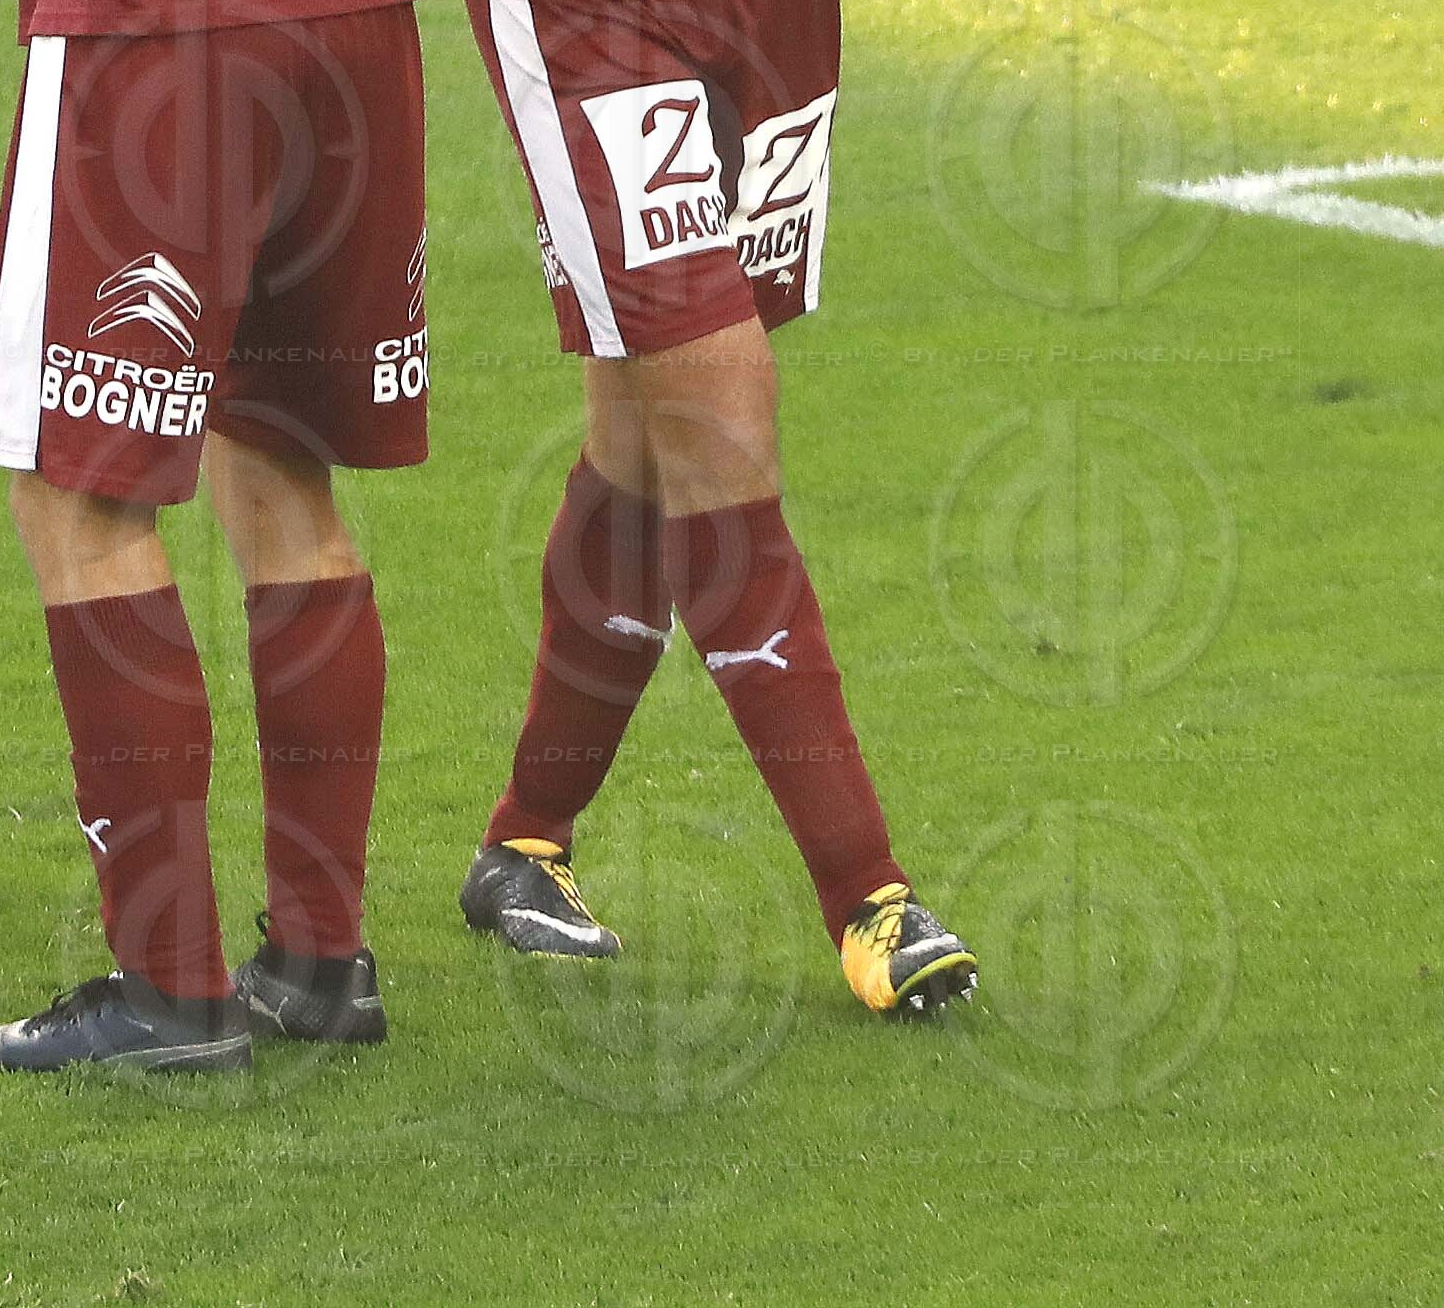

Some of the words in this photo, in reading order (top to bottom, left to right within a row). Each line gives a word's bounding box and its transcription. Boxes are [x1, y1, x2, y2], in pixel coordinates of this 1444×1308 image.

[736, 208, 813, 269] DACH
[375, 326, 427, 362] CIT
[41, 365, 208, 437] BOGNER
